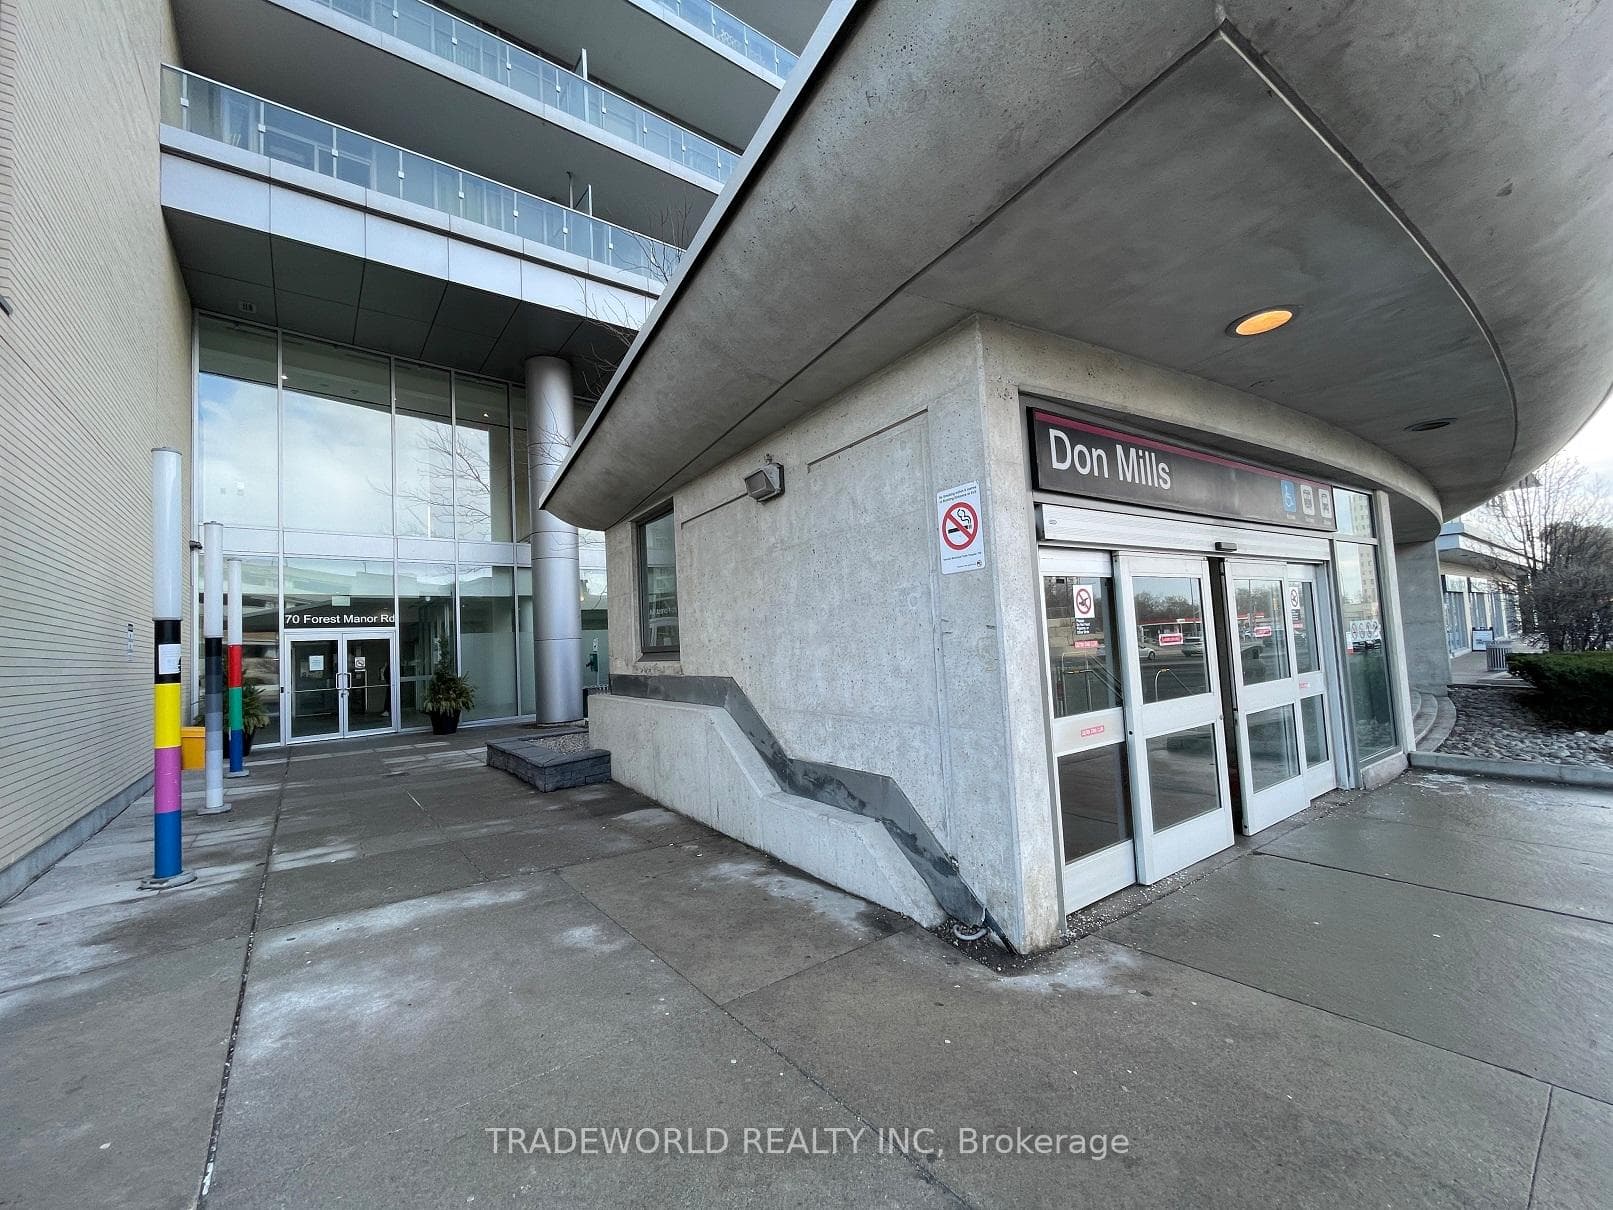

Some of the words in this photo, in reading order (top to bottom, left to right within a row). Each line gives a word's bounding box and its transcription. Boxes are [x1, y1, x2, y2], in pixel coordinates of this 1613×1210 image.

[1049, 428, 1109, 479] Don
[1115, 444, 1171, 490] Mills
[285, 614, 300, 624] 70
[303, 614, 341, 624] Forest
[343, 614, 378, 624] Manor
[380, 613, 396, 623] Rd
